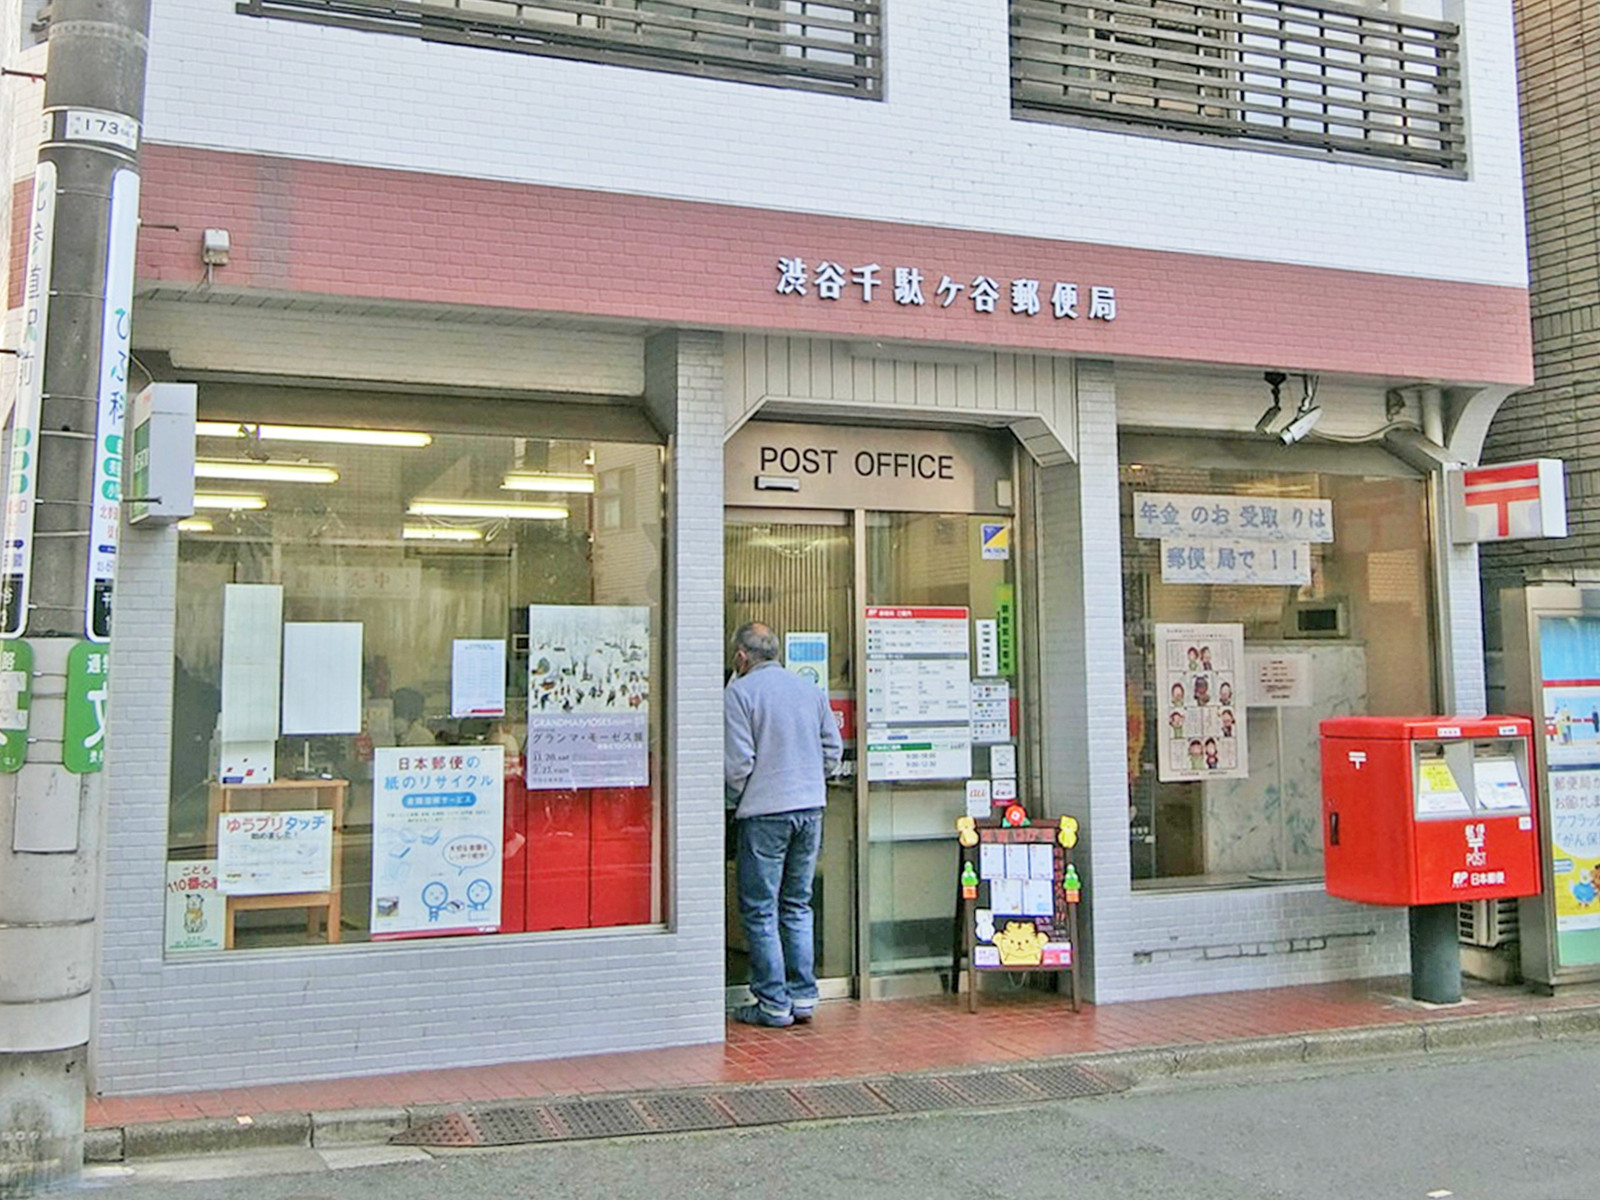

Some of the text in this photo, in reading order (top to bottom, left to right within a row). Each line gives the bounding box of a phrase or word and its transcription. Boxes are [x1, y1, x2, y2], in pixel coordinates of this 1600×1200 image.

[85, 118, 119, 135] 173
[760, 447, 954, 479] POST OFFICE
[399, 756, 480, 771] 日本郵便の
[385, 775, 494, 790] 紙のリサイクル
